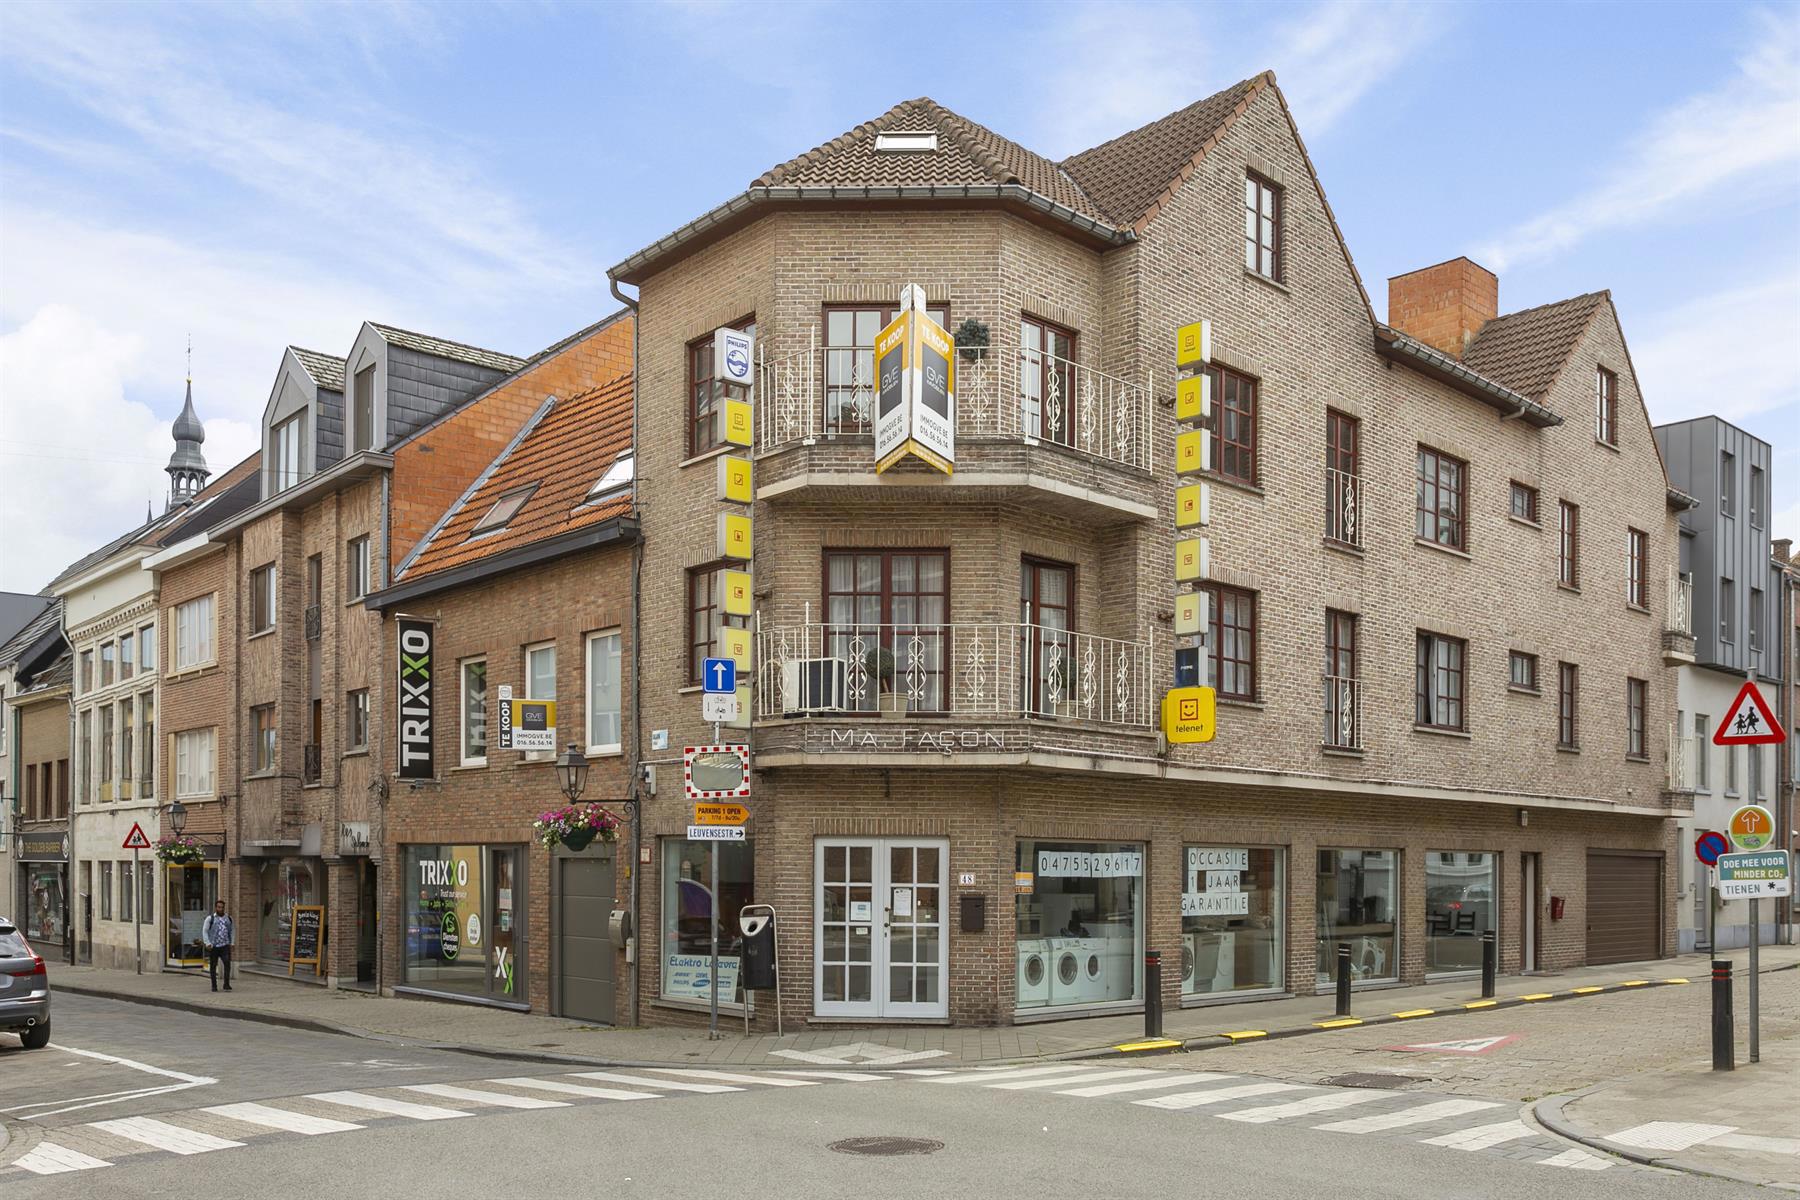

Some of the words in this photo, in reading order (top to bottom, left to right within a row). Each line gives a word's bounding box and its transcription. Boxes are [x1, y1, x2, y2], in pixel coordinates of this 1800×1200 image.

[727, 339, 748, 350] PHILIPS
[879, 341, 887, 354] TE
[887, 325, 904, 348] KOOP
[921, 325, 930, 341] TE
[930, 333, 950, 354] KOOP
[919, 413, 949, 439] IMMOGVE.BE
[919, 427, 949, 450] 016.56.56.14
[402, 629, 430, 767] TRIXXO
[501, 702, 510, 731] KOOP
[1175, 724, 1203, 733] telenet
[501, 733, 510, 746] TE
[831, 729, 878, 748] MA
[902, 729, 1006, 756] FAÇON
[697, 807, 722, 815] PARKING
[689, 828, 736, 839] LEUVENSESTR.
[1041, 857, 1141, 872] 0475529617
[1189, 850, 1247, 866] OCCASIE
[1723, 860, 1740, 869] DOE
[1741, 858, 1759, 868] MEE
[1761, 857, 1784, 866] VOOR
[419, 859, 468, 887] TRIXXO
[959, 875, 974, 884] 48
[1734, 869, 1766, 879] MINDER
[1190, 875, 1196, 888] 1
[1208, 874, 1239, 888] JAAR
[1725, 883, 1761, 895] TIENEN
[1181, 896, 1247, 912] GARANTIE
